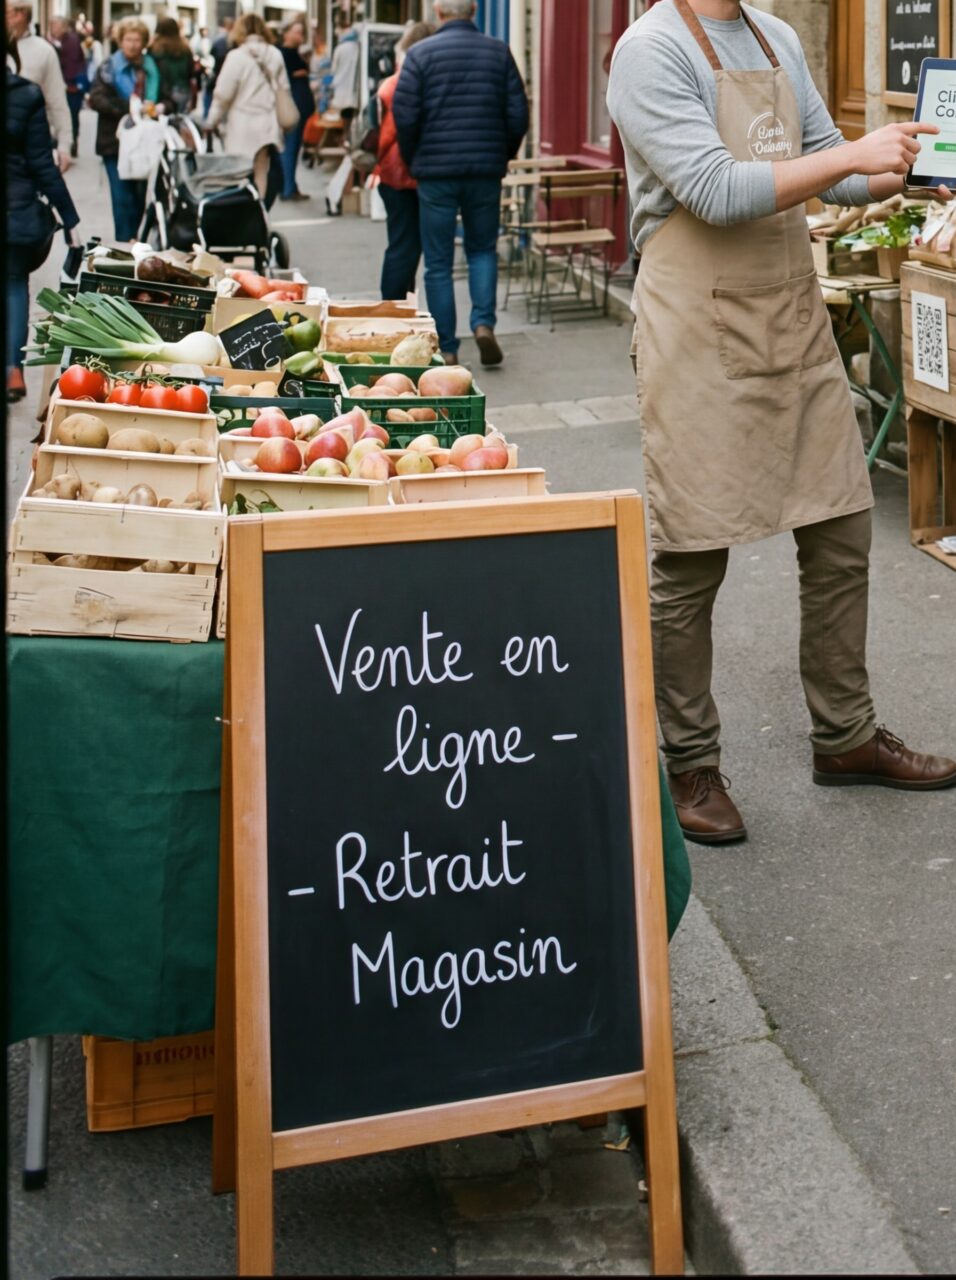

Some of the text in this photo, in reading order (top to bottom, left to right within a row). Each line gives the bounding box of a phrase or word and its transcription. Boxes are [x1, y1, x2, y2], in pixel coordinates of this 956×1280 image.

[314, 608, 570, 695] Vente en
[383, 704, 536, 810] ligne
[335, 820, 527, 911] Retrait
[352, 927, 578, 1030] Magasin
